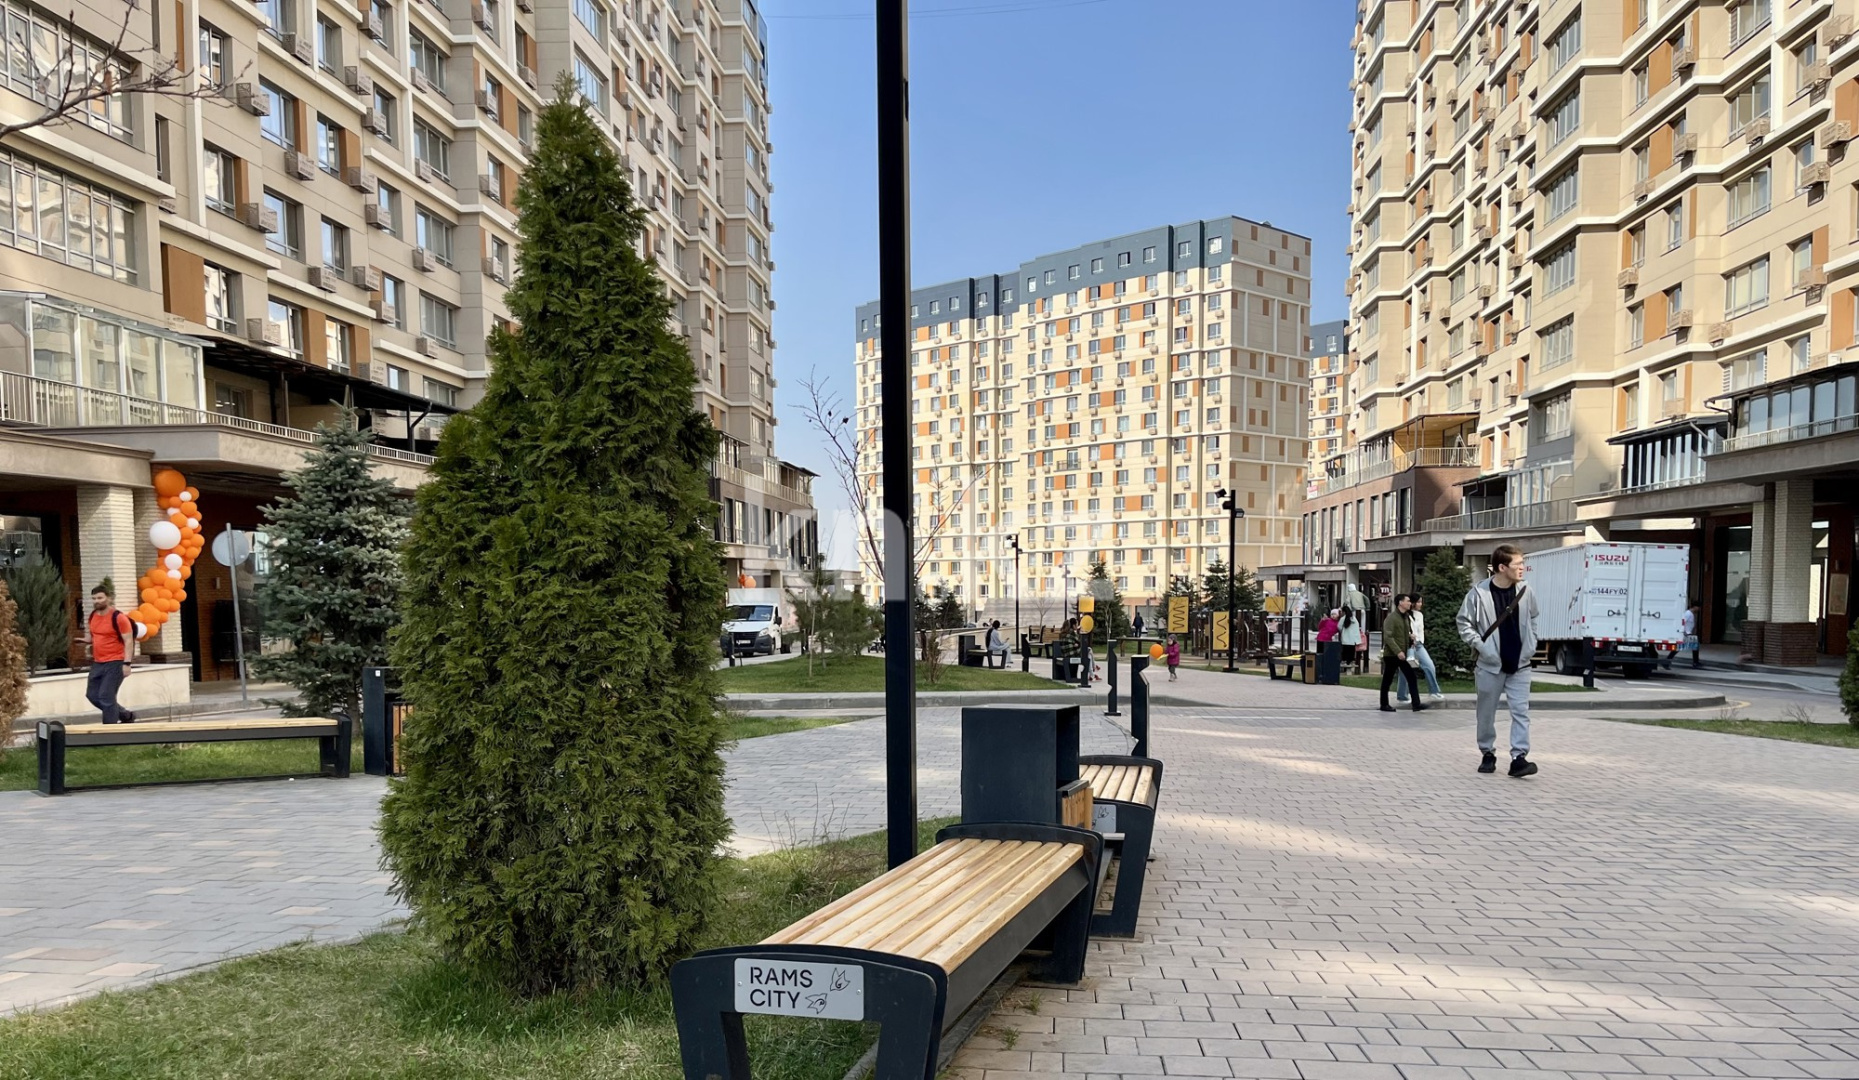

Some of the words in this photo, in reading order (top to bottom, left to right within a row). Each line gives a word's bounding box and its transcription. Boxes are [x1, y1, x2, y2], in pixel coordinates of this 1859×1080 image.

[1595, 554, 1629, 562] ISUZU
[750, 966, 813, 988] RAMS
[750, 989, 801, 1009] CITY
